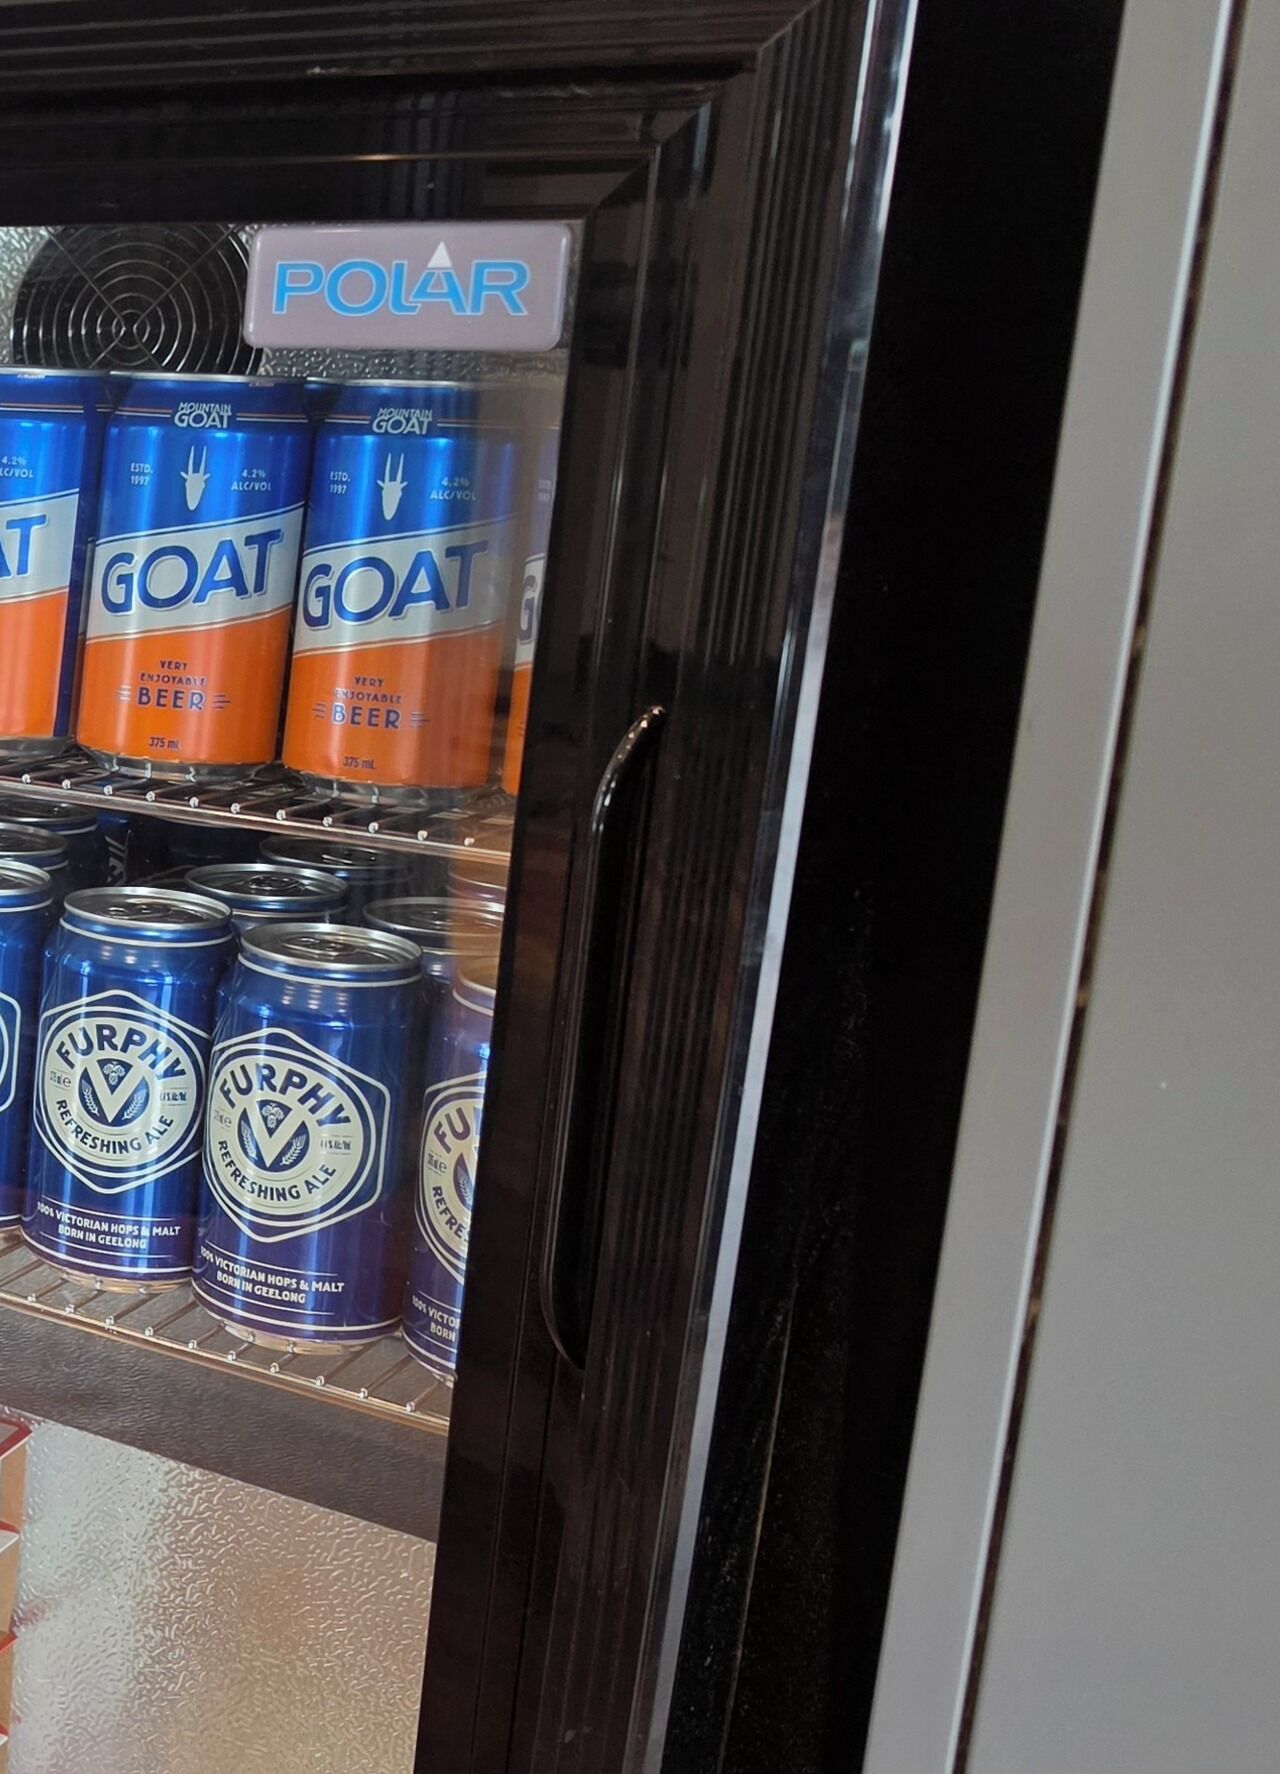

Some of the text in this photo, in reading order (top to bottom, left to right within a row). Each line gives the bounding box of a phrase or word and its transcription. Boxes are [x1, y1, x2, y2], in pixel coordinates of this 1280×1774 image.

[272, 240, 530, 316] POLAR
[178, 401, 232, 415] MOUNTAIN
[377, 407, 433, 421] MOUNTAIN
[174, 411, 232, 429] GOAT
[372, 417, 433, 435] GOAT
[130, 475, 149, 487] 1997
[231, 480, 271, 492] ALC/VOL
[330, 471, 351, 483] ESTD.
[329, 483, 347, 495] 1997
[430, 489, 477, 501] ALC/VOL
[100, 528, 284, 616] GOAT
[302, 540, 488, 631] GOAT
[159, 659, 188, 671] VERY
[140, 672, 208, 687] ENJOYABLE
[354, 676, 384, 688] VERY
[137, 687, 205, 711] BEER
[331, 703, 402, 729] BEER
[148, 736, 164, 749] 375
[343, 755, 361, 769] 375
[56, 1023, 188, 1081] FURPHY
[219, 1062, 352, 1128] FURPHY
[56, 1098, 175, 1155] REFRESHING ALE
[218, 1139, 337, 1202] REFRESHING ALE
[56, 1208, 109, 1232] VICTORIAN
[110, 1222, 139, 1236] HOPS
[152, 1225, 181, 1237] MALT
[58, 1222, 84, 1241] BORN
[97, 1232, 147, 1249] GEELONG
[214, 1256, 266, 1283] VICTORIAN
[267, 1273, 298, 1289] HOPS
[311, 1279, 345, 1293] MALT
[216, 1269, 240, 1291] BORN
[253, 1283, 307, 1304] GEELONG
[428, 1305, 461, 1329] VICTO
[429, 1321, 457, 1343] BORN
